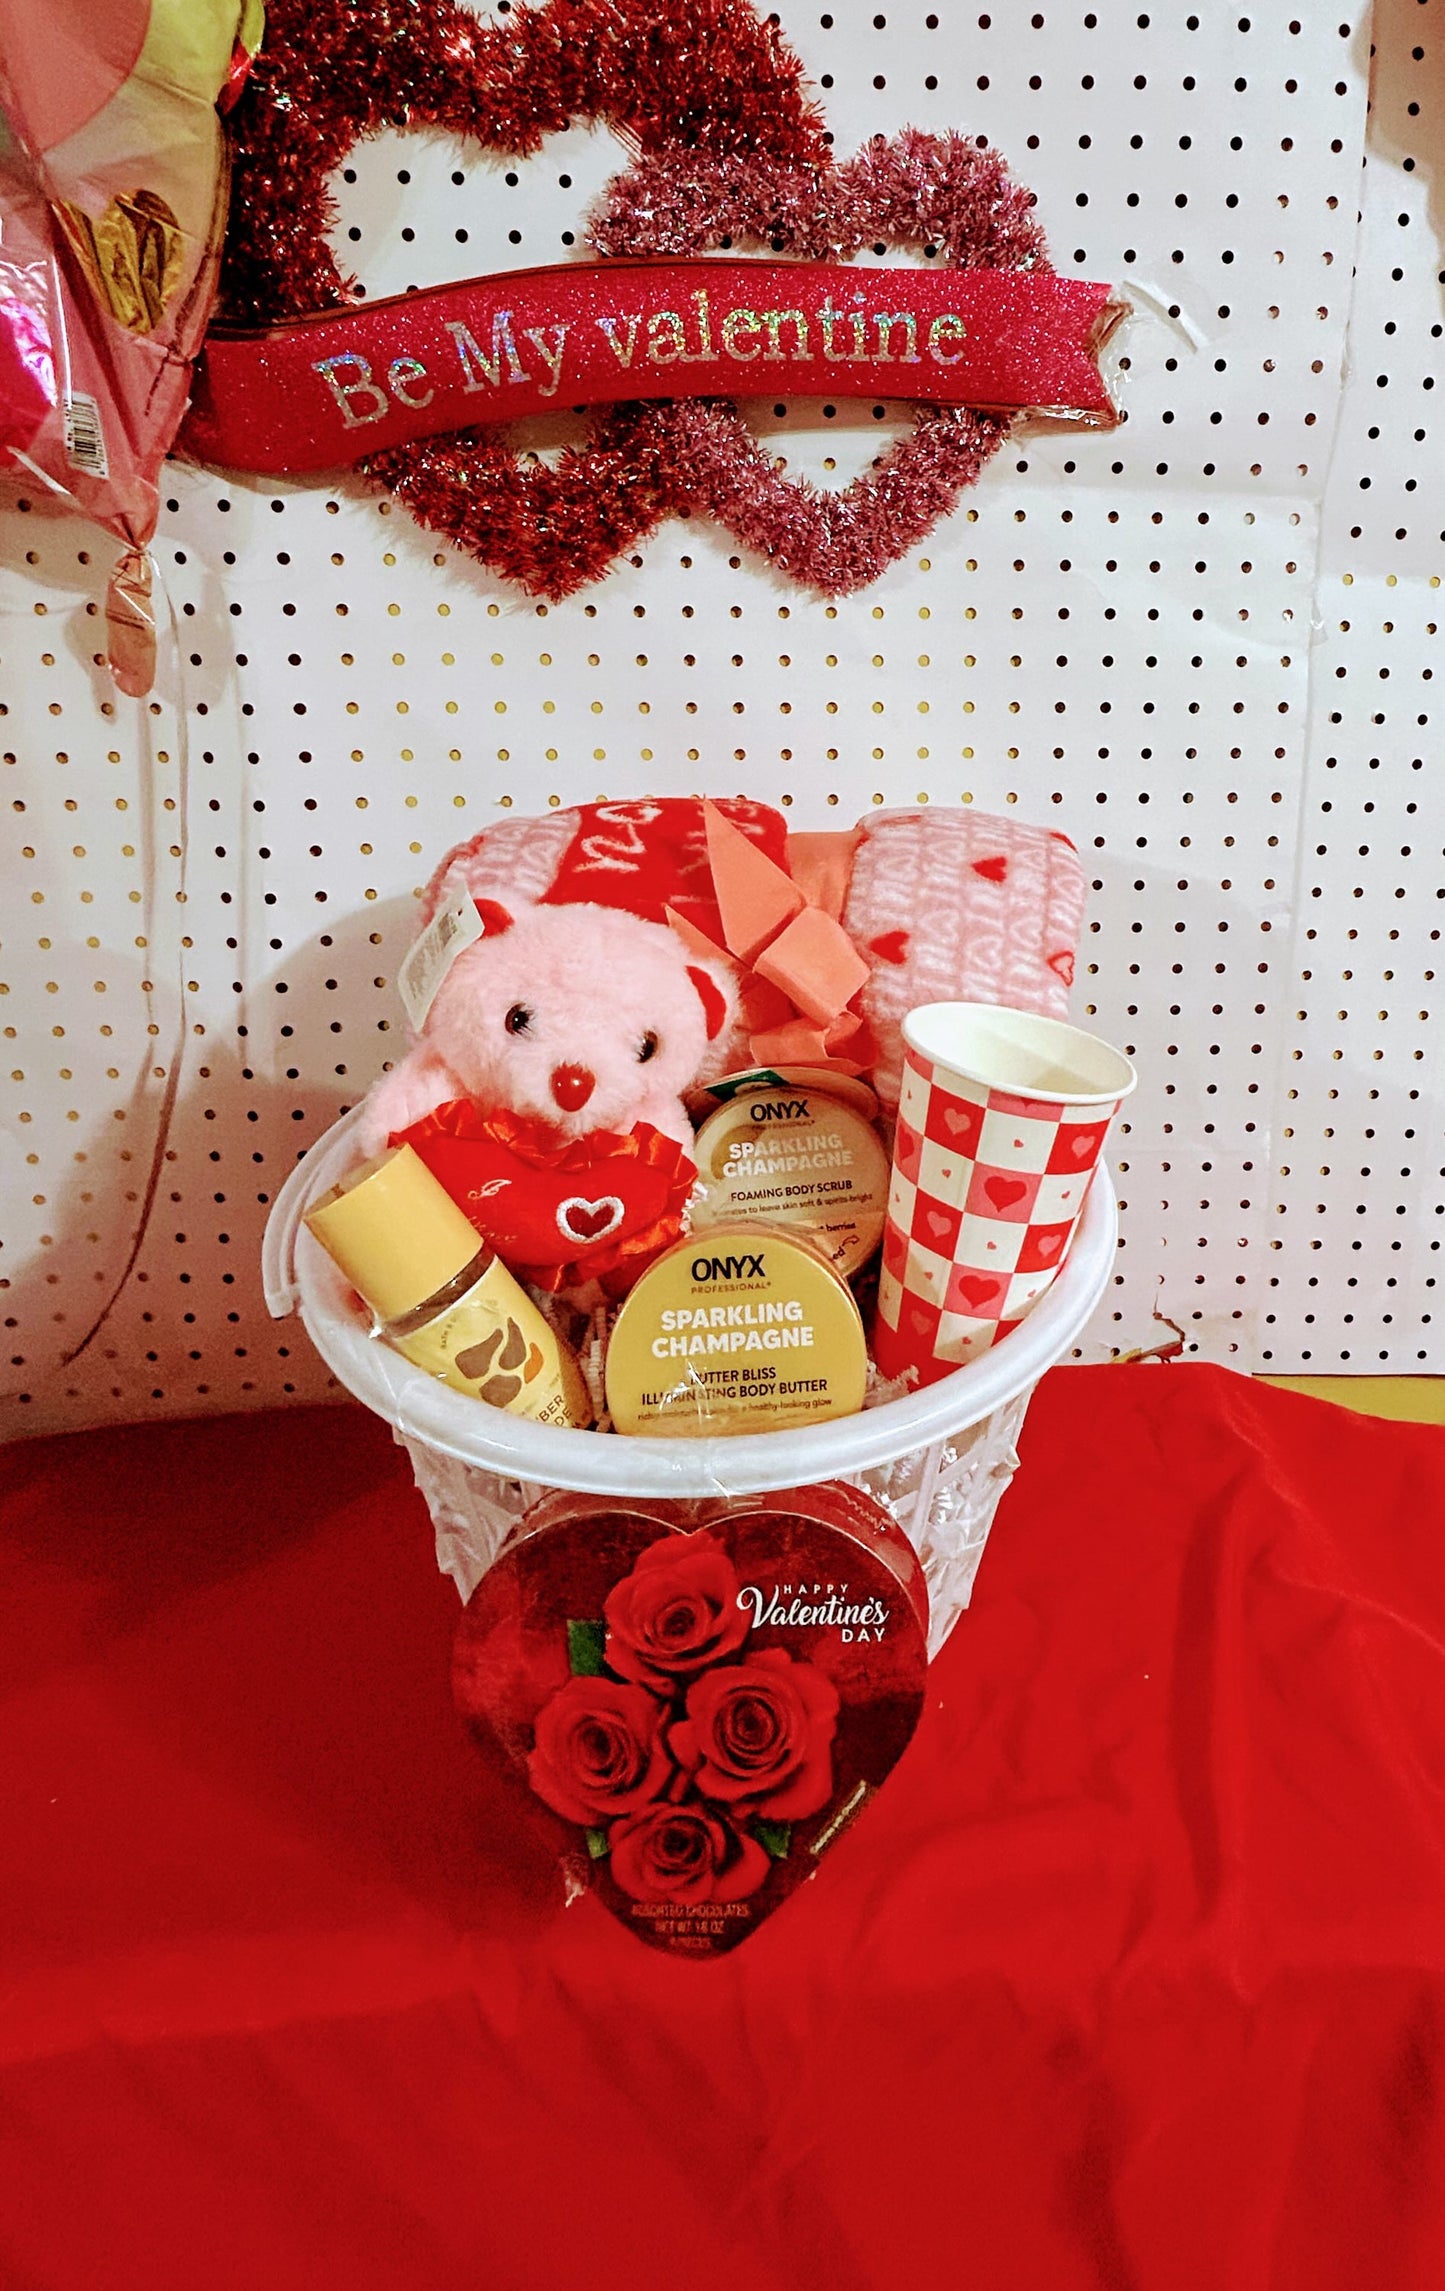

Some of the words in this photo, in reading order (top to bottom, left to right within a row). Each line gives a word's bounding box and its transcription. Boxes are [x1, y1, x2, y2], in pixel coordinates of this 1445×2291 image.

[312, 351, 435, 430] Be
[444, 310, 570, 396] My
[595, 289, 968, 367] valentine
[751, 1100, 811, 1122] ONYX
[729, 1134, 843, 1160] SPARKLING
[722, 1151, 854, 1178] CHAMPAGNE
[731, 1185, 783, 1202] FOAMING
[785, 1183, 816, 1196] BODY
[817, 1180, 853, 1193] SCRUB
[691, 1254, 765, 1282] ONYX
[661, 1301, 803, 1331] SPARKLING
[652, 1327, 814, 1358] CHAMPAGNE
[742, 1367, 777, 1382] BLISS
[739, 1383, 776, 1397] BODY
[779, 1379, 828, 1395] BUTTER
[783, 1584, 849, 1594] HAPPY
[736, 1584, 890, 1629] Valentine's
[841, 1628, 886, 1643] DAY
